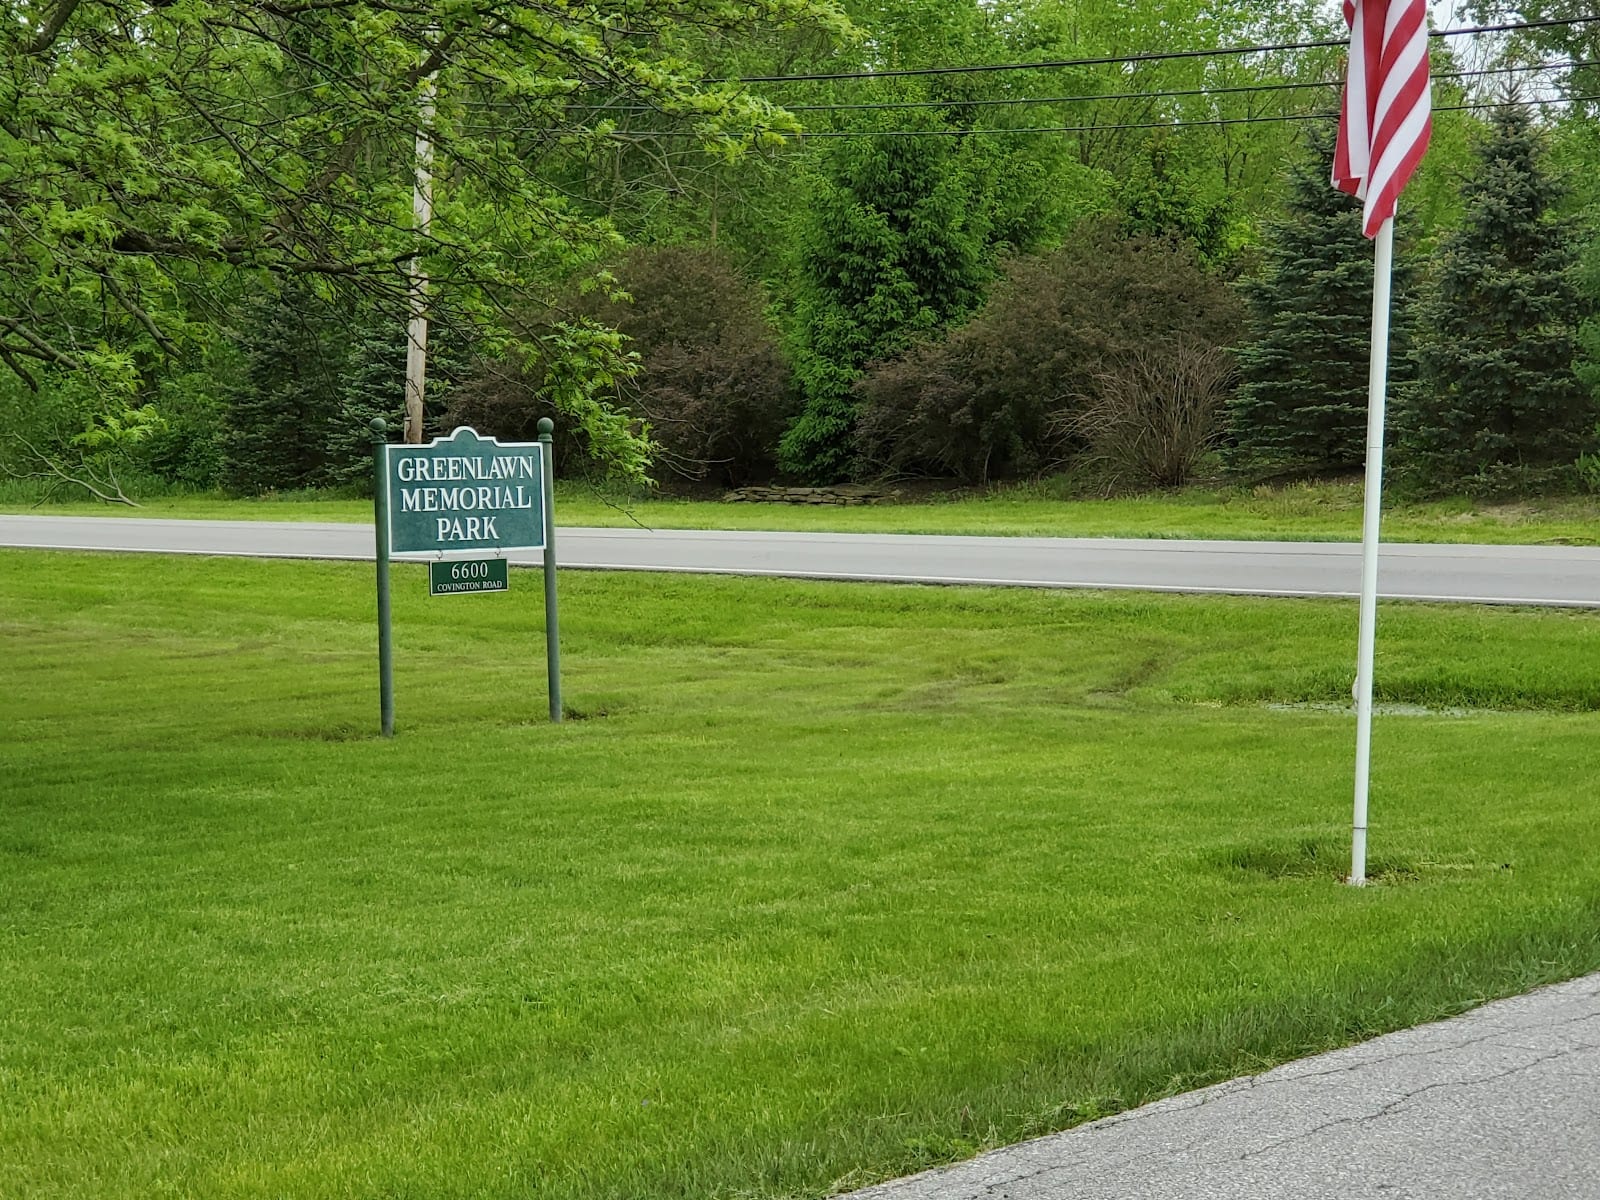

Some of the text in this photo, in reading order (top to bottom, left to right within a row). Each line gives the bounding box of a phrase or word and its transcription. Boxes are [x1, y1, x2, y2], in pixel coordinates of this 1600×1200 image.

[397, 455, 533, 481] GREENLAWN
[400, 485, 532, 512] MEMORIAL
[436, 516, 499, 541] PARK
[451, 562, 488, 579] 6600
[437, 581, 503, 592] COVINGTON ROAD
